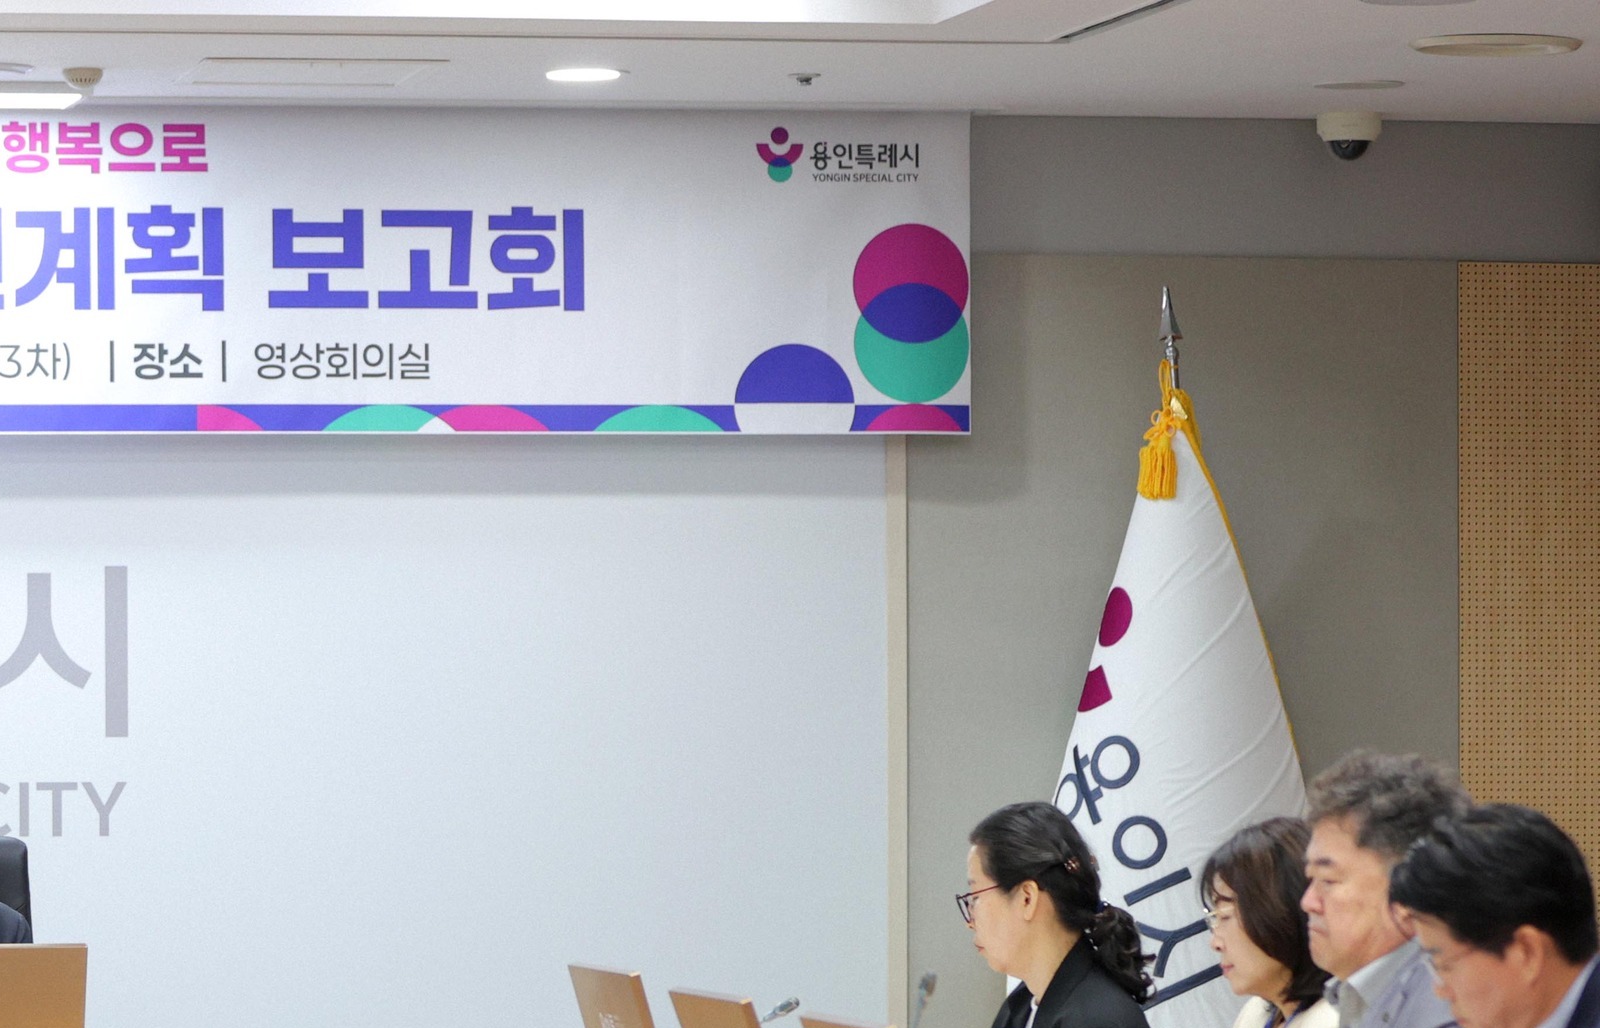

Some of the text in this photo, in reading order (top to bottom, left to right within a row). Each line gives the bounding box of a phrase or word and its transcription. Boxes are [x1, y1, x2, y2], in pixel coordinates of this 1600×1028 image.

[2, 119, 209, 174] 행복으로
[810, 141, 919, 171] 용인특례시
[811, 172, 919, 183] YONGIN SPECIAL CITY
[268, 205, 586, 312] 보고회
[133, 343, 204, 383] 장소
[254, 342, 431, 382] 영상회의실
